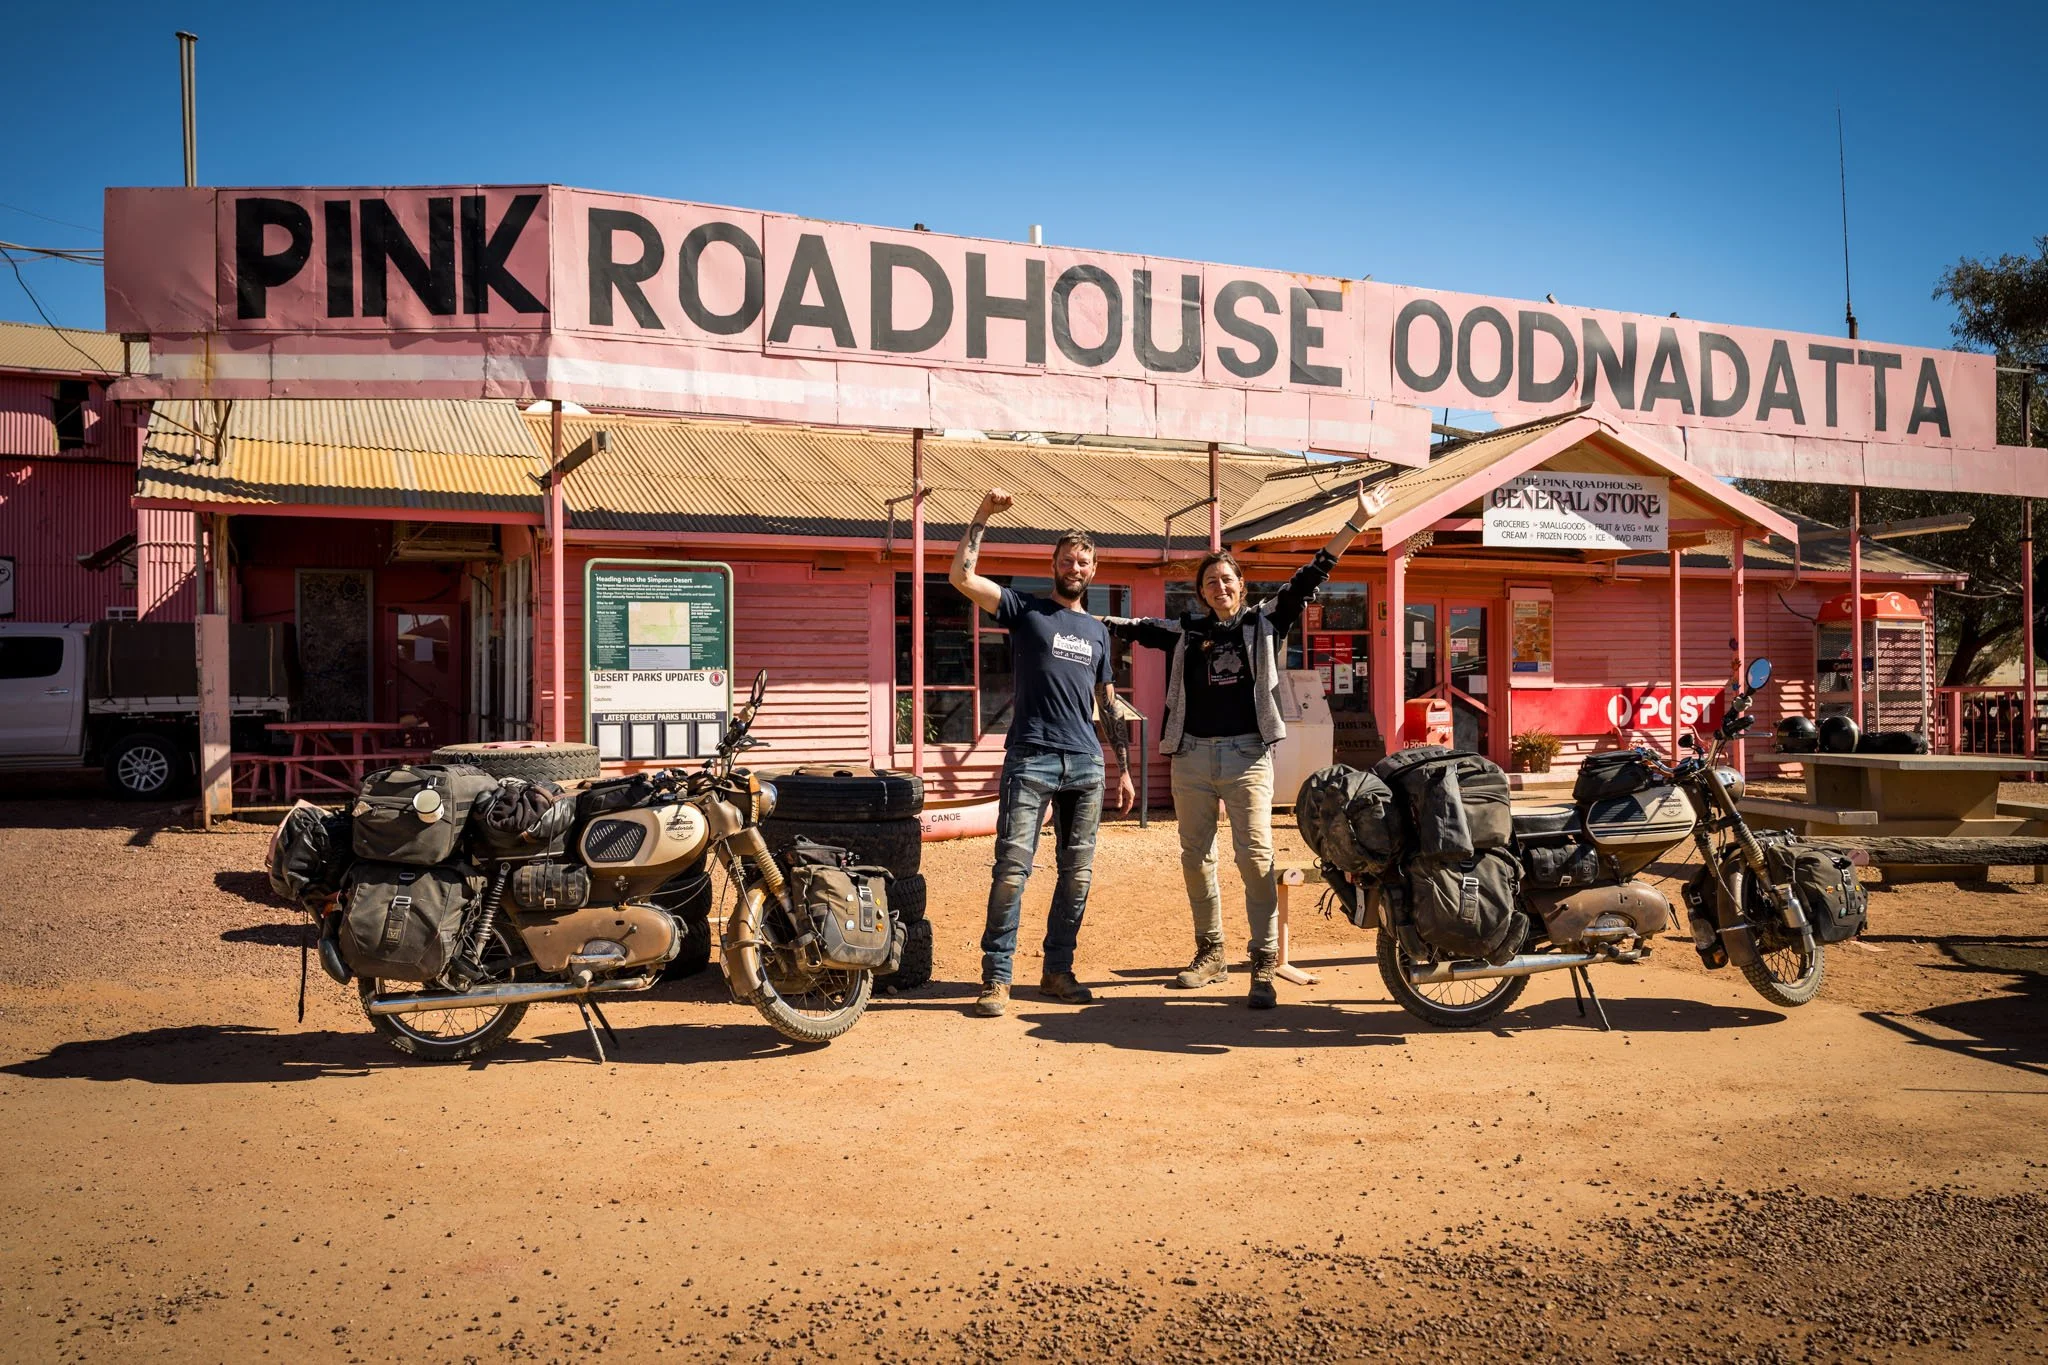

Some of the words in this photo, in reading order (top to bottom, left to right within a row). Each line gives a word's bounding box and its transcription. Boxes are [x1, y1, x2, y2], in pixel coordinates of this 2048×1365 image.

[236, 195, 549, 319] PINK
[588, 207, 1342, 387] ROADHOUSE
[1393, 298, 1951, 438] OODNADATTA
[1513, 477, 1540, 486] THE
[1543, 478, 1570, 489] PINK
[1573, 480, 1642, 490] ROADHOUSE
[1492, 487, 1589, 515] GENERAL
[1594, 492, 1660, 518] STORE
[1492, 519, 1530, 529] GROCERIES
[1539, 521, 1586, 530] SMALLGOODS
[1594, 523, 1612, 531] FRUIT
[1622, 524, 1636, 532] VEG
[1501, 530, 1528, 539] CREAM
[1536, 532, 1562, 540] FROZEN
[1563, 533, 1587, 541] FOODS
[1614, 534, 1631, 542] 4WD
[1632, 535, 1652, 543] PARTS
[594, 672, 629, 682] DESERT
[632, 672, 662, 682] PARKS
[665, 672, 705, 681] UPDATES
[1639, 694, 1714, 725] POST
[603, 713, 628, 721] LATEST
[629, 713, 656, 721] DESERT
[681, 712, 717, 720] BULLETINS
[1333, 721, 1375, 730] HOUSE
[1436, 726, 1453, 734] POST
[931, 813, 961, 823] CANOE
[920, 825, 932, 833] RE
